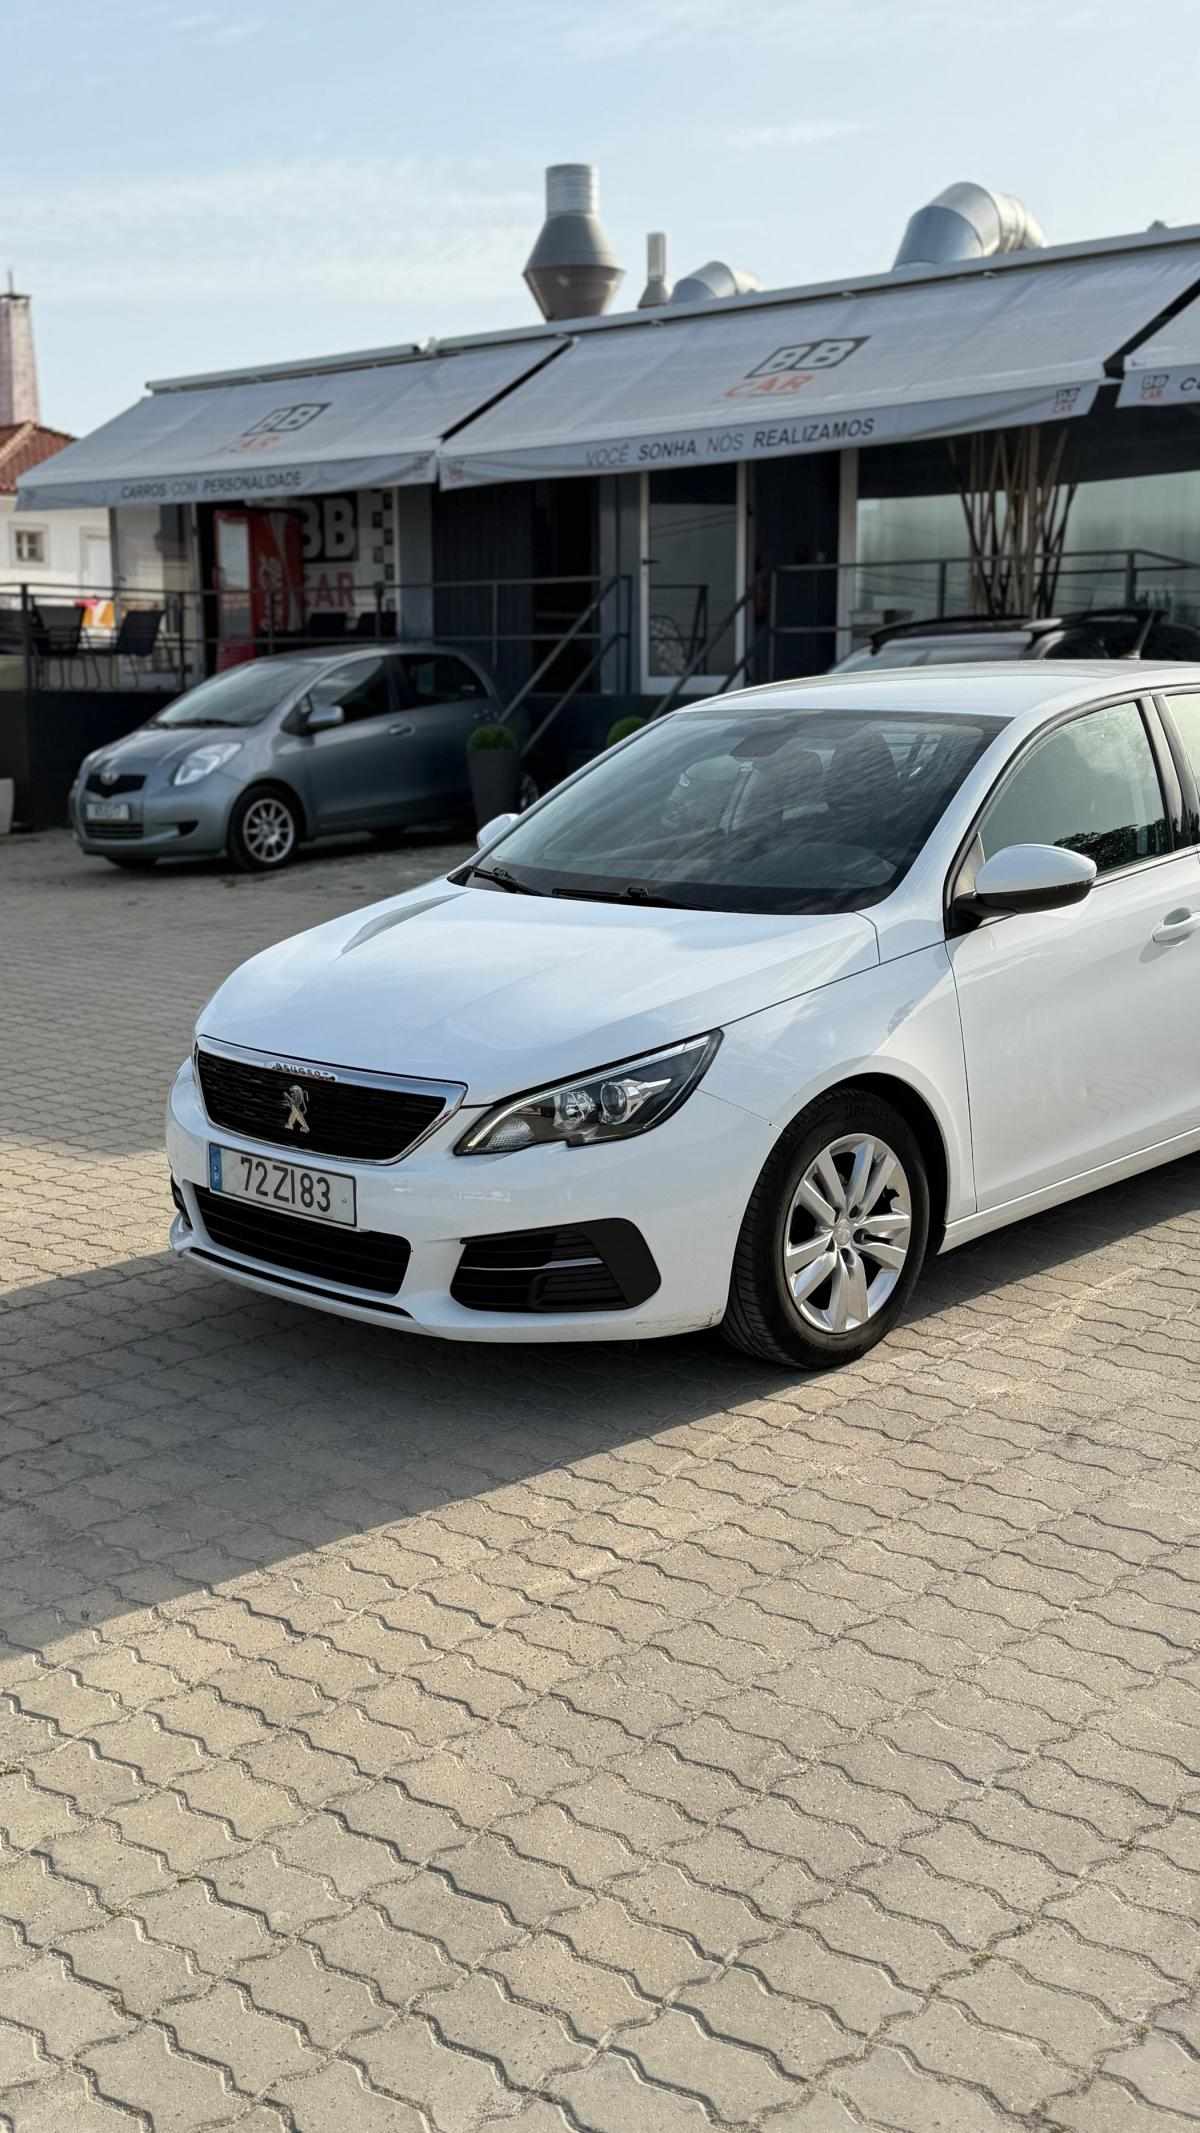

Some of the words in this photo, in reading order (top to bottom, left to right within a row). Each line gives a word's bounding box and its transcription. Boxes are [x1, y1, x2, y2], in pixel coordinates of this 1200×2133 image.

[745, 336, 870, 379] BB
[724, 375, 816, 397] CAR
[585, 444, 631, 467] VOCÊ
[753, 418, 875, 448] REALIZAMOS
[121, 480, 167, 499] CARROS
[203, 470, 301, 494] PERSONALIDADE
[240, 1156, 331, 1212] 72ZI83
